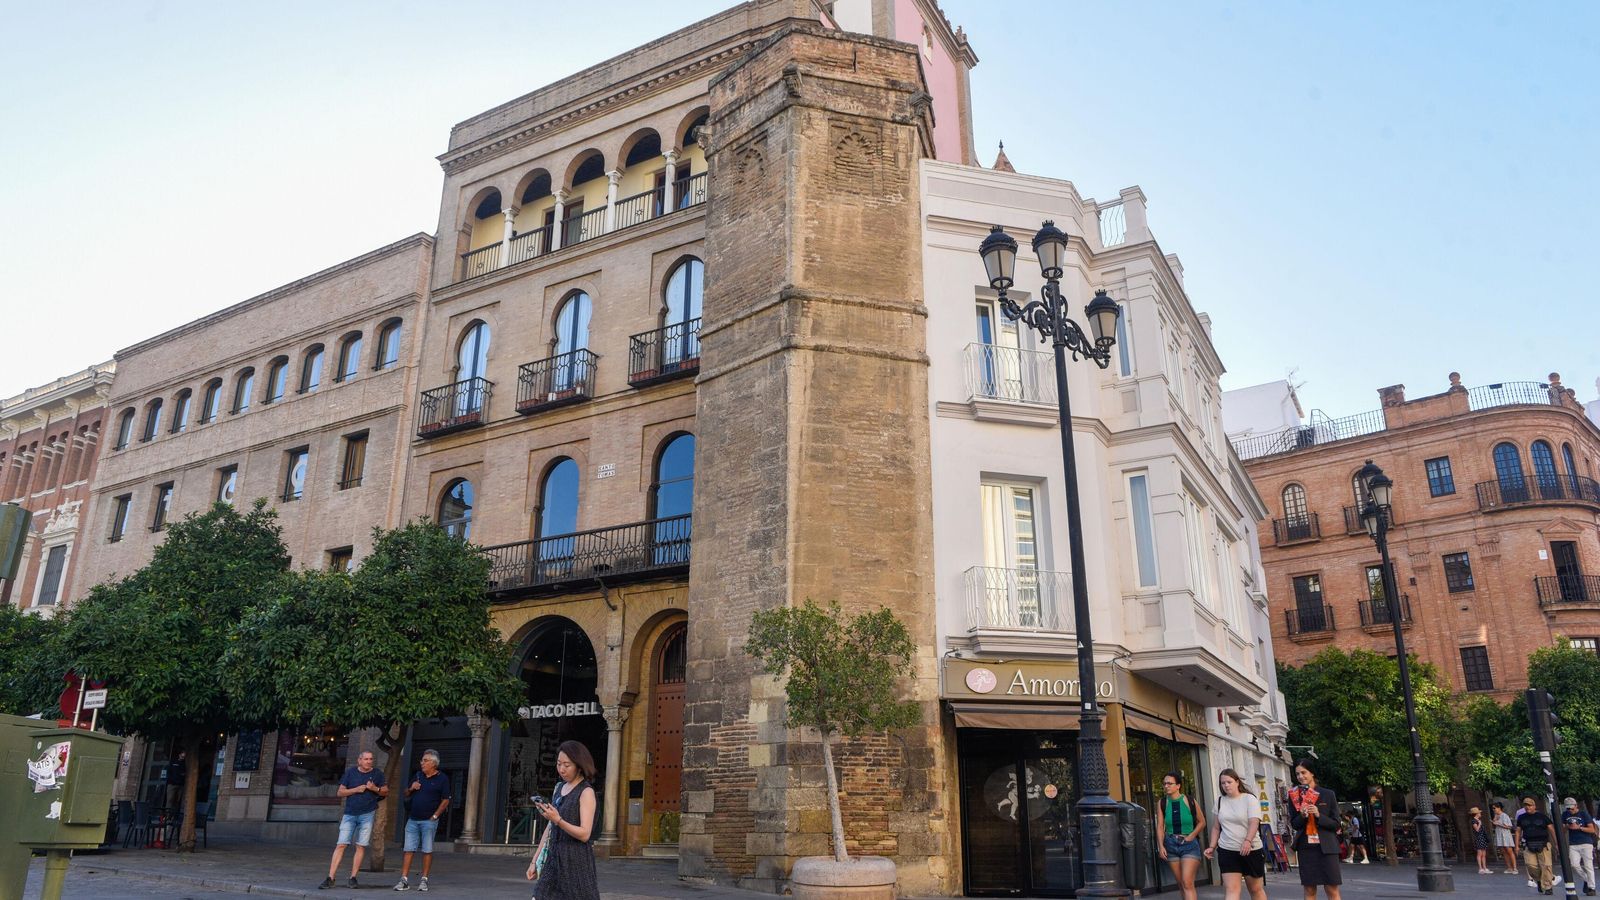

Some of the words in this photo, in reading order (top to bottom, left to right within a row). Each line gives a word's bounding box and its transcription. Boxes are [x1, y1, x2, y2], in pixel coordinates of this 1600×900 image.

[1007, 669, 1113, 697] Amoro
[530, 704, 566, 718] TACO
[566, 702, 599, 716] BELL
